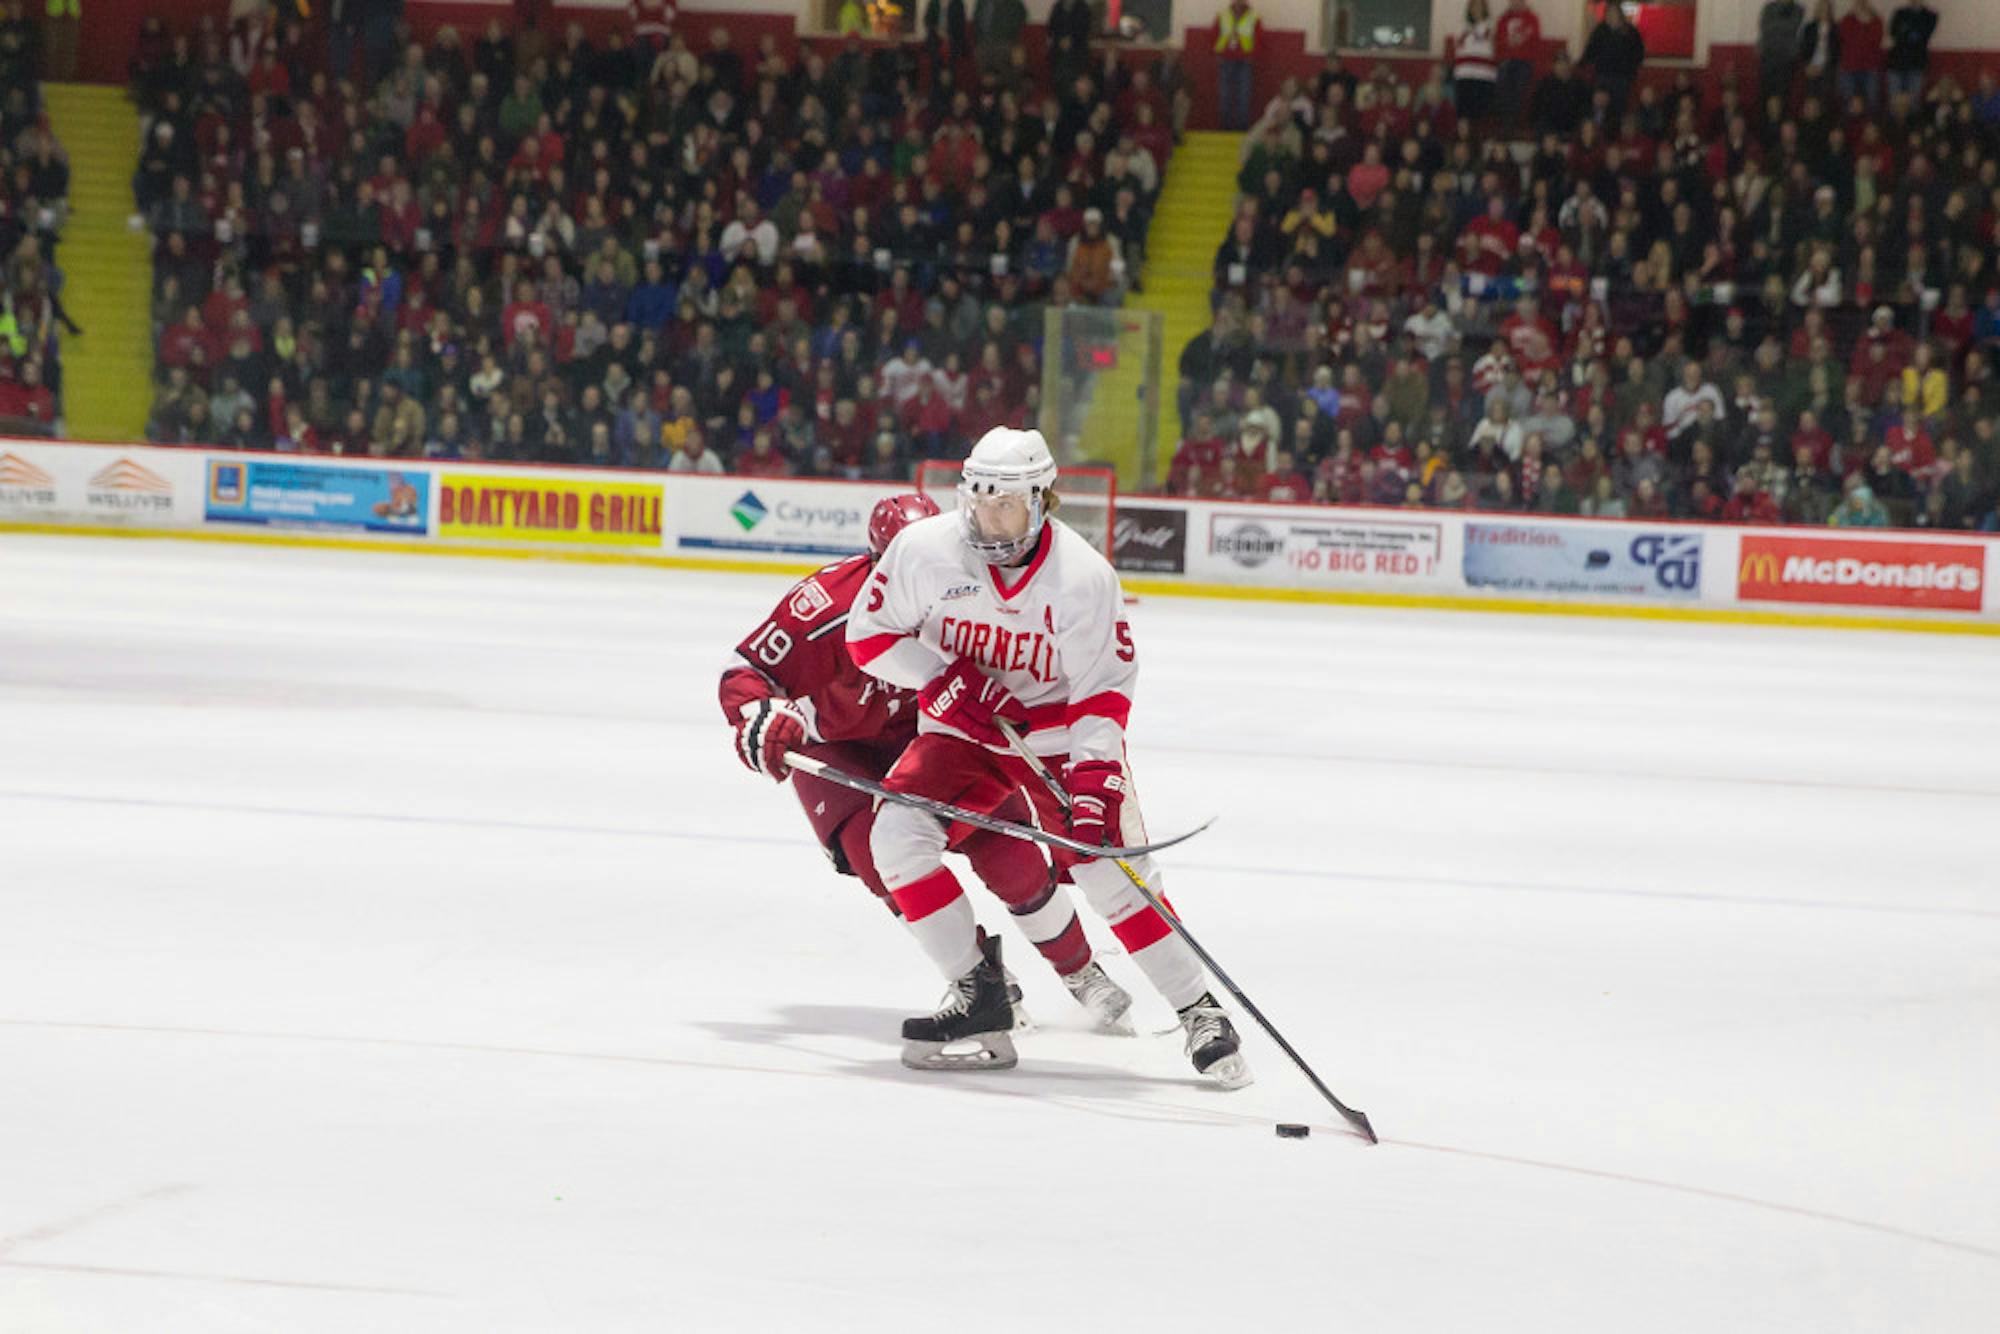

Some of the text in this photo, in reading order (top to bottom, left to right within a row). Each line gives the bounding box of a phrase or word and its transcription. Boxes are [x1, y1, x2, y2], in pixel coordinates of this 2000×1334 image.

[440, 486, 662, 535] BOATYARD GRILL
[776, 501, 861, 527] Cayuga
[1216, 535, 1284, 555] ECONOMY
[1329, 550, 1367, 572] BIG
[1375, 552, 1420, 575] RED
[1783, 555, 1980, 592] McDonald's
[749, 620, 794, 666] 19
[940, 615, 1059, 684] CORNELL
[1115, 621, 1136, 662] 5
